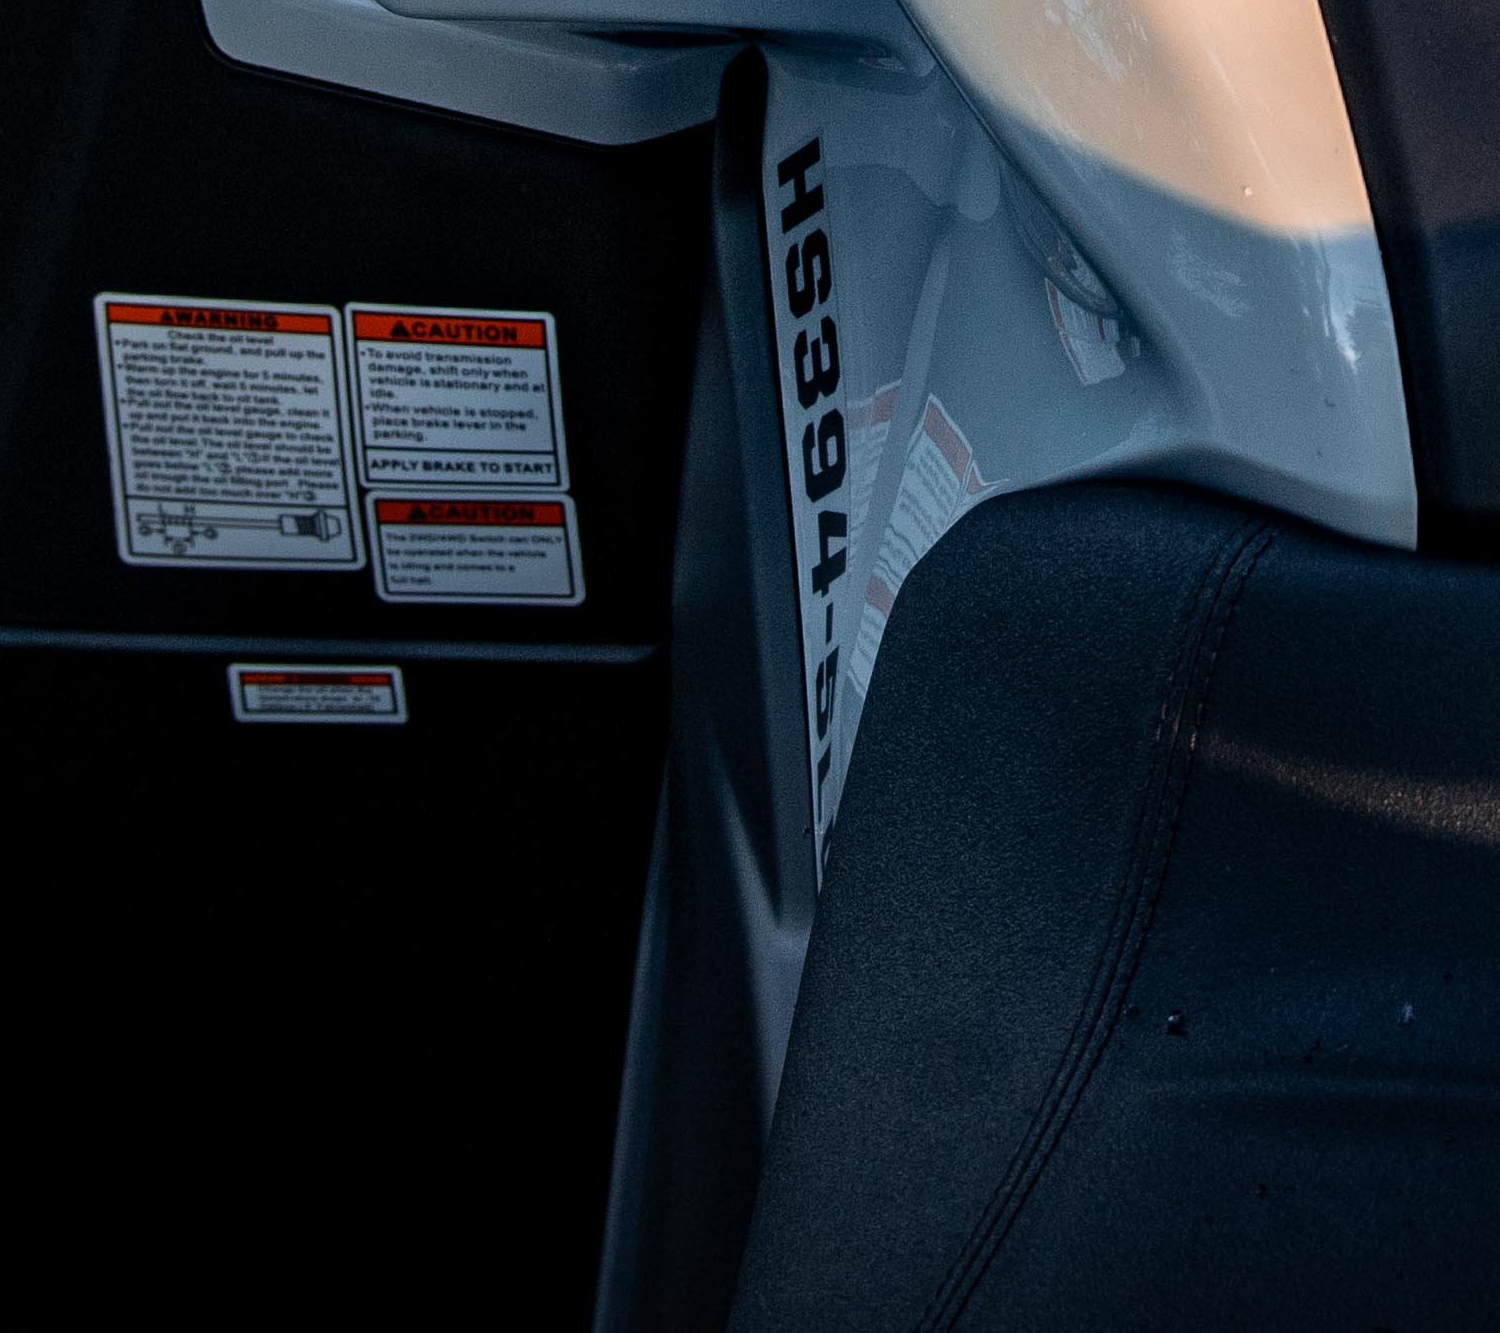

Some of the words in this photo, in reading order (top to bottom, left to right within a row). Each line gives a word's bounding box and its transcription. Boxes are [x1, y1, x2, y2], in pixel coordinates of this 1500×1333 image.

[177, 312, 279, 328] WARNING
[412, 322, 517, 341] CAUTION
[367, 348, 383, 358] To
[386, 349, 422, 361] avoid
[425, 352, 512, 365] transmission
[429, 366, 459, 376] shift
[462, 368, 490, 379] only
[492, 369, 528, 379] when
[370, 377, 416, 387] vehicle
[420, 379, 430, 387] is
[433, 380, 500, 392] stationary
[504, 383, 529, 392] and
[533, 384, 546, 393] at
[373, 403, 409, 414] When
[412, 405, 461, 416] vehicle
[465, 407, 476, 416] is
[372, 417, 408, 428] place
[411, 418, 449, 428] brake
[453, 419, 486, 429] lever
[491, 420, 502, 429] in
[506, 421, 526, 431] the
[371, 460, 418, 471] APPLY
[423, 461, 475, 472] BRAKE
[480, 462, 500, 473] TO
[504, 463, 553, 474] START
[430, 507, 535, 520] CAUTION
